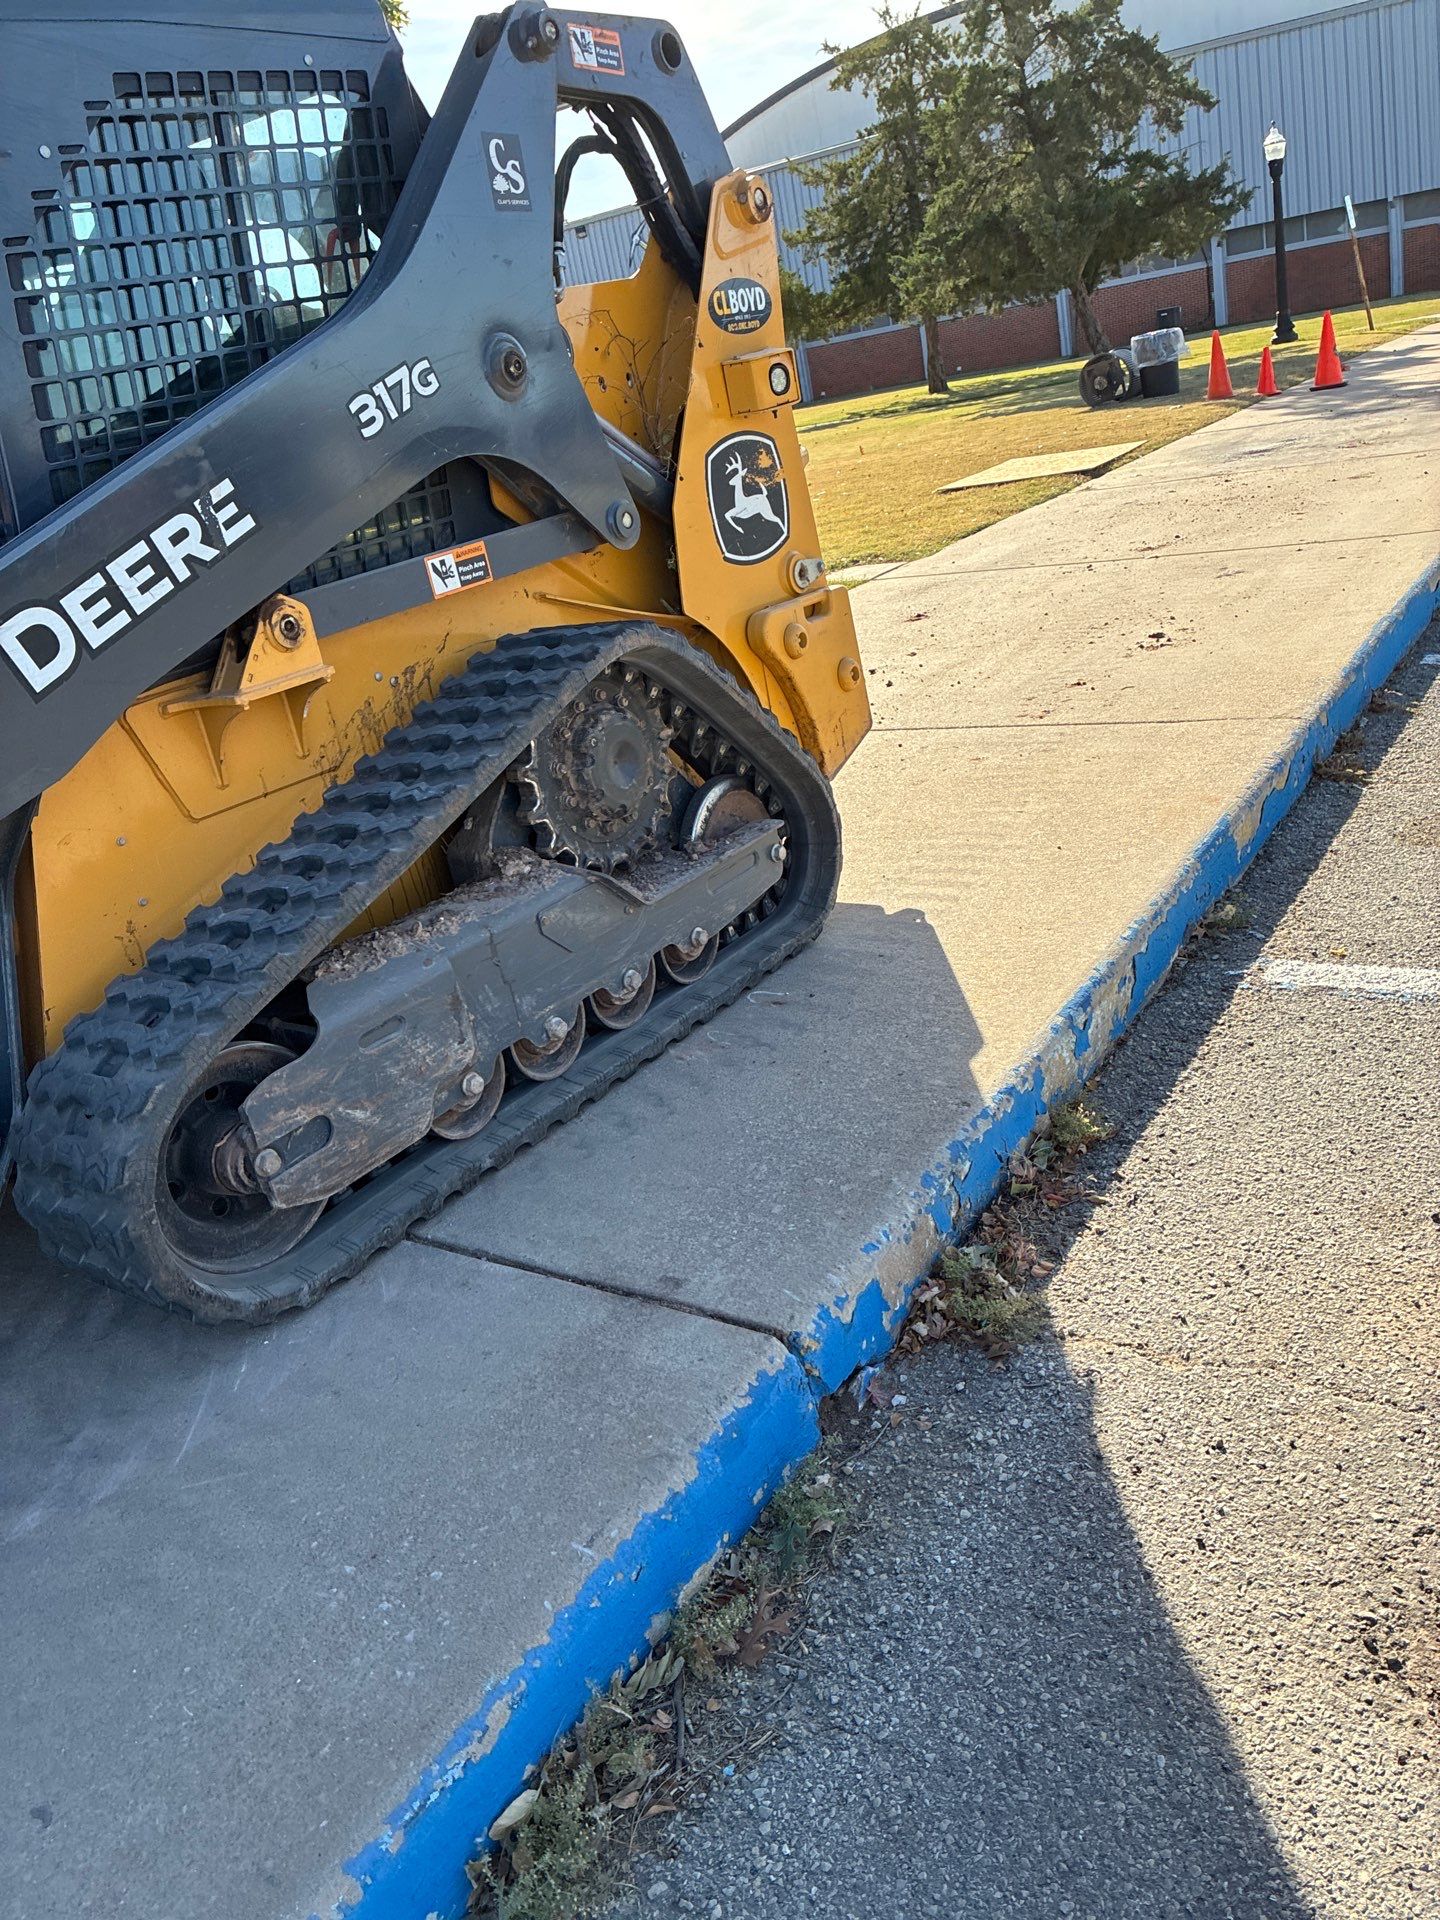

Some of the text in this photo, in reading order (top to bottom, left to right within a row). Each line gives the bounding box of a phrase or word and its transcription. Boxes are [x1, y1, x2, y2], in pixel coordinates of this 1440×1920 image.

[348, 359, 440, 438] 317G
[460, 545, 484, 556] WARNING
[458, 560, 486, 573] Pinch Area
[460, 570, 484, 582] Keep Away
[0, 477, 257, 694] DEERE
